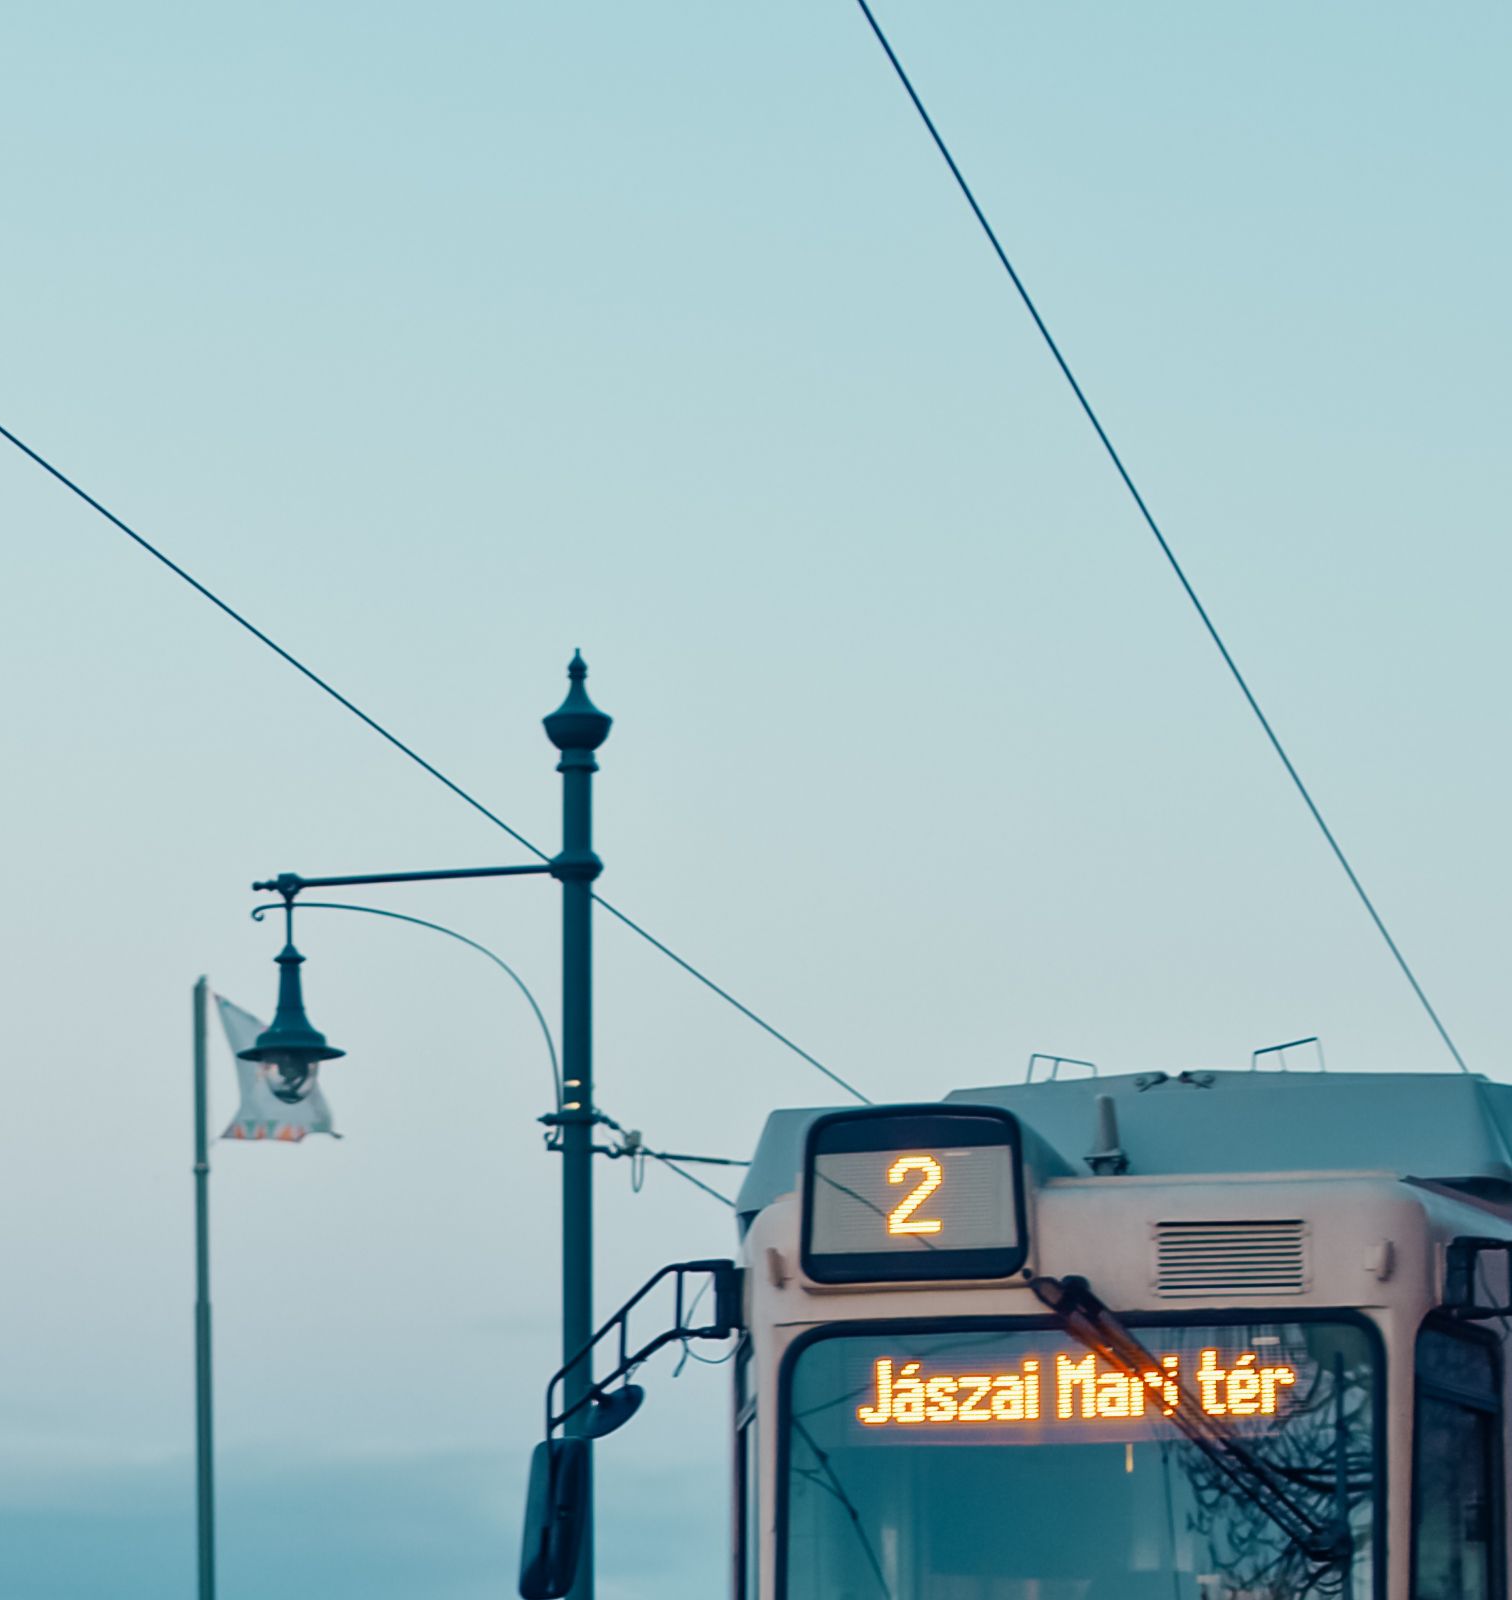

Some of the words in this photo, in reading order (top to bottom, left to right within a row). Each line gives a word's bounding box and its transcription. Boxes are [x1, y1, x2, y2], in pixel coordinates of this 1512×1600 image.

[888, 1155, 943, 1234] 2
[858, 1358, 1040, 1423] Jászai
[1056, 1353, 1179, 1419] Mari
[1196, 1348, 1296, 1416] tér
